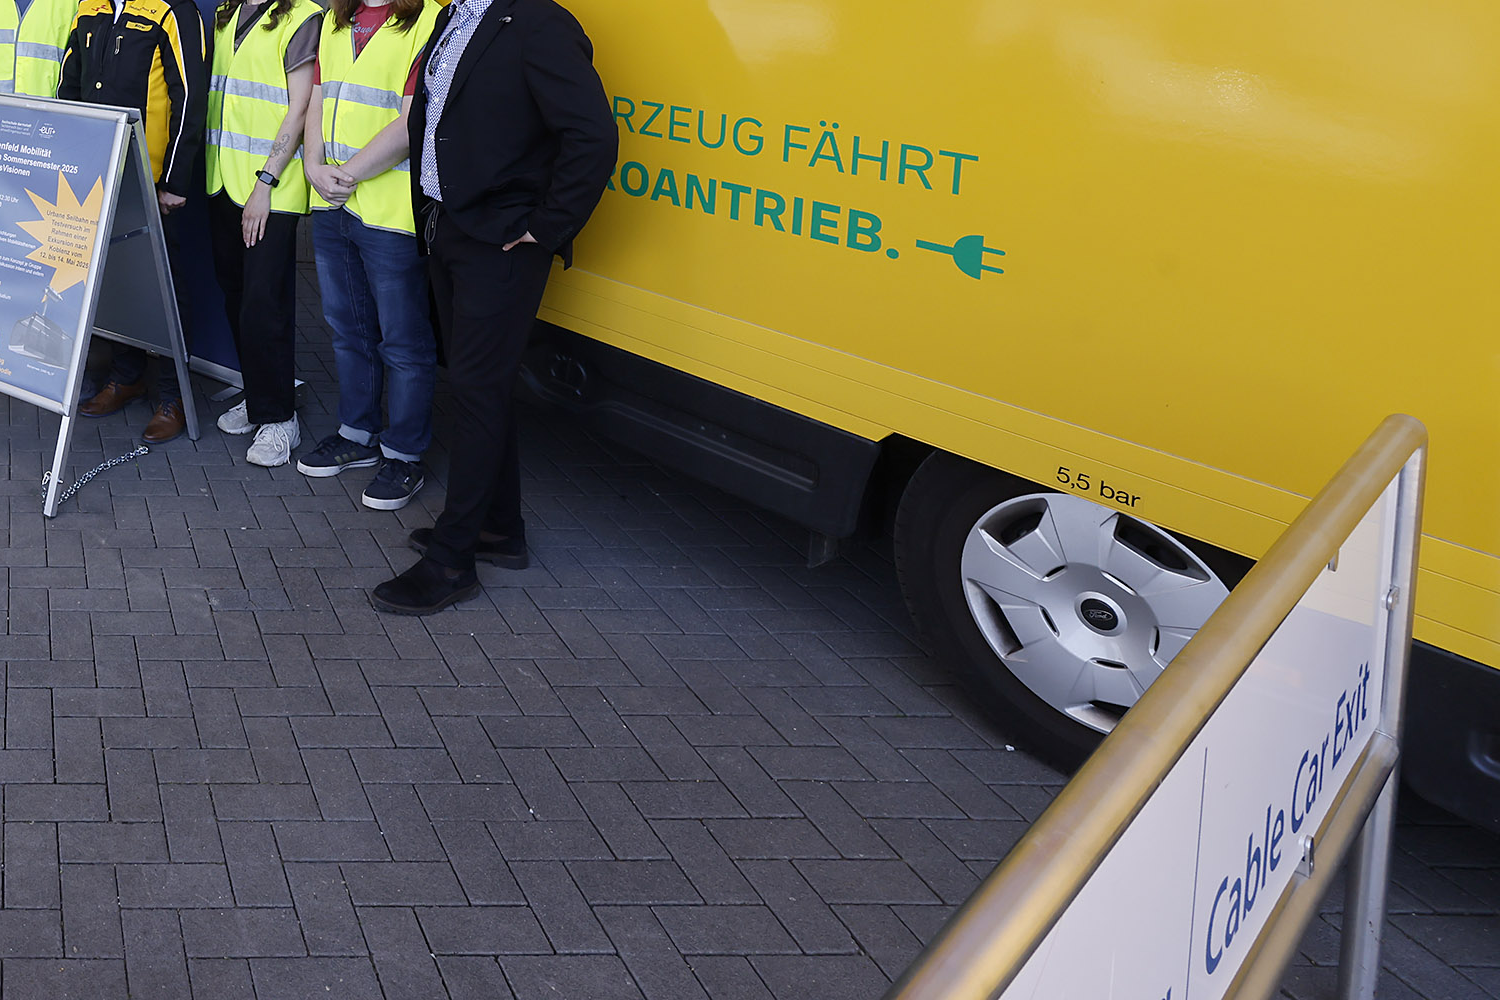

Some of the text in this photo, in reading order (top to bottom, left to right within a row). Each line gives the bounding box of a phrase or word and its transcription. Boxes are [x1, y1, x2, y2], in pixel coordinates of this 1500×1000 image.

[20, 145, 51, 158] Mobilität
[782, 120, 980, 196] FÄHRT
[3, 154, 60, 171] Sommersemester
[61, 164, 78, 174] 2025
[46, 210, 65, 219] Urbane
[66, 214, 89, 224] Seilbahn
[52, 219, 83, 231] Testversuch
[51, 228, 73, 238] Rahmen
[48, 236, 74, 247] Exkursion
[49, 246, 70, 256] Koblenz
[76, 260, 88, 269] 2025
[1056, 466, 1140, 508] 5,5 bar
[1205, 660, 1370, 975] Cable Car Exit
